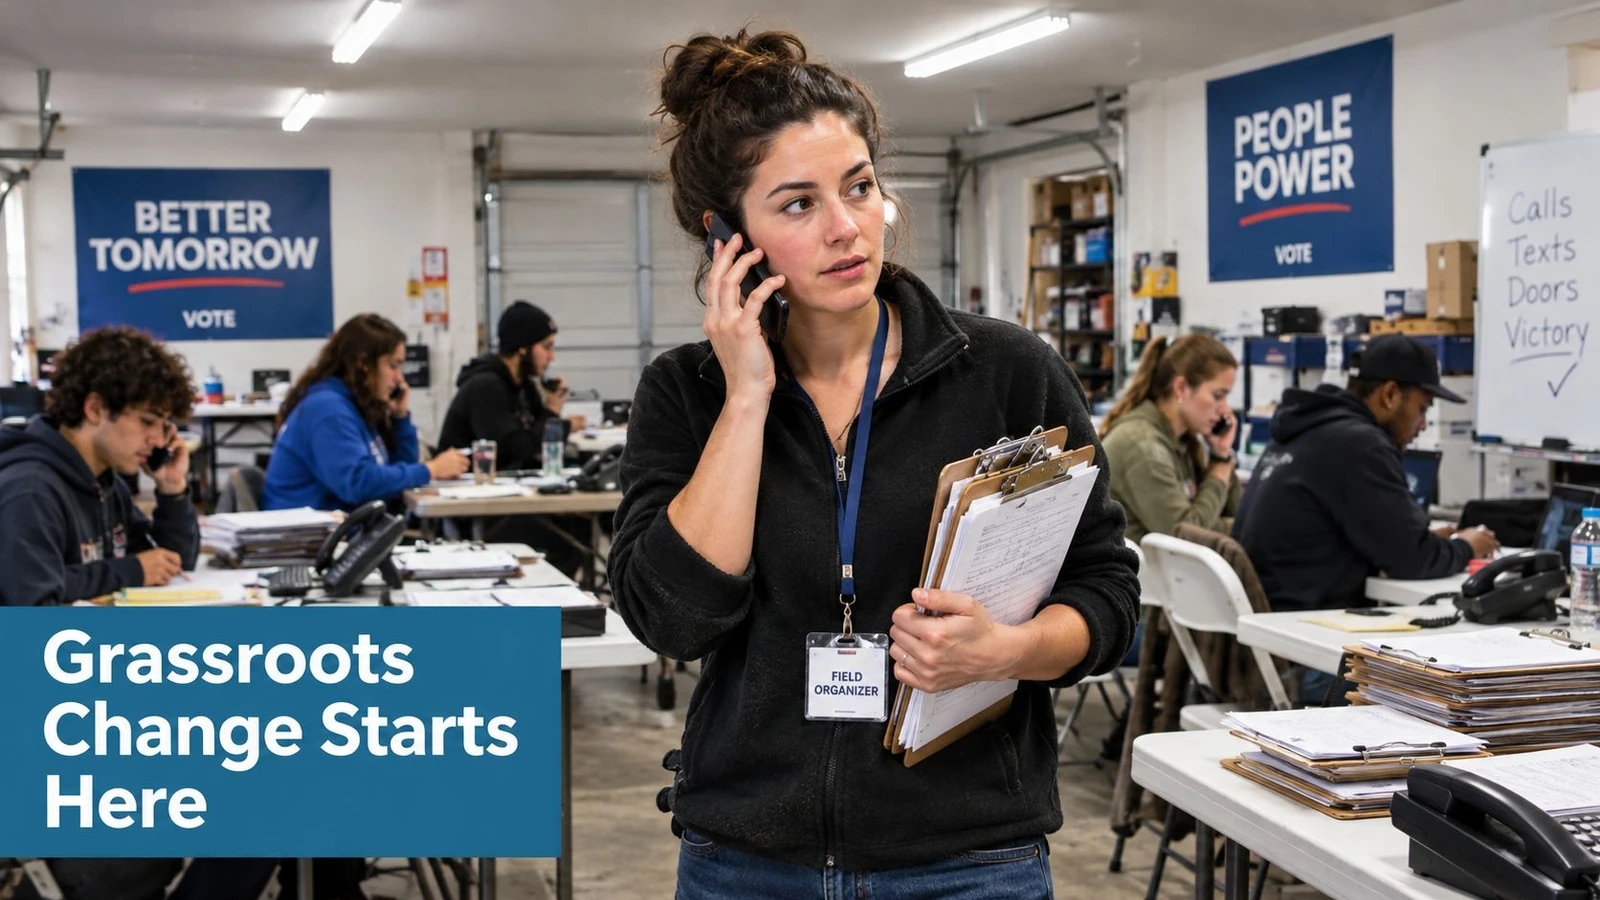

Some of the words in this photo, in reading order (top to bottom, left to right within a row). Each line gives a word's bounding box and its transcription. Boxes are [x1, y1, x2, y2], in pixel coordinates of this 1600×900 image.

[1234, 93, 1353, 158] PEOPLE
[1234, 144, 1355, 204] POWER
[134, 200, 273, 234] BETTER
[1508, 187, 1573, 225] Calls
[89, 237, 320, 272] TOMORROW
[1274, 243, 1313, 266] VOTE
[1508, 234, 1577, 267] Texts
[1508, 276, 1580, 308] Doors
[182, 310, 237, 329] VOTE
[1504, 317, 1590, 359] Victory
[814, 685, 879, 697] ORGANIZER
[831, 671, 863, 682] FIELD
